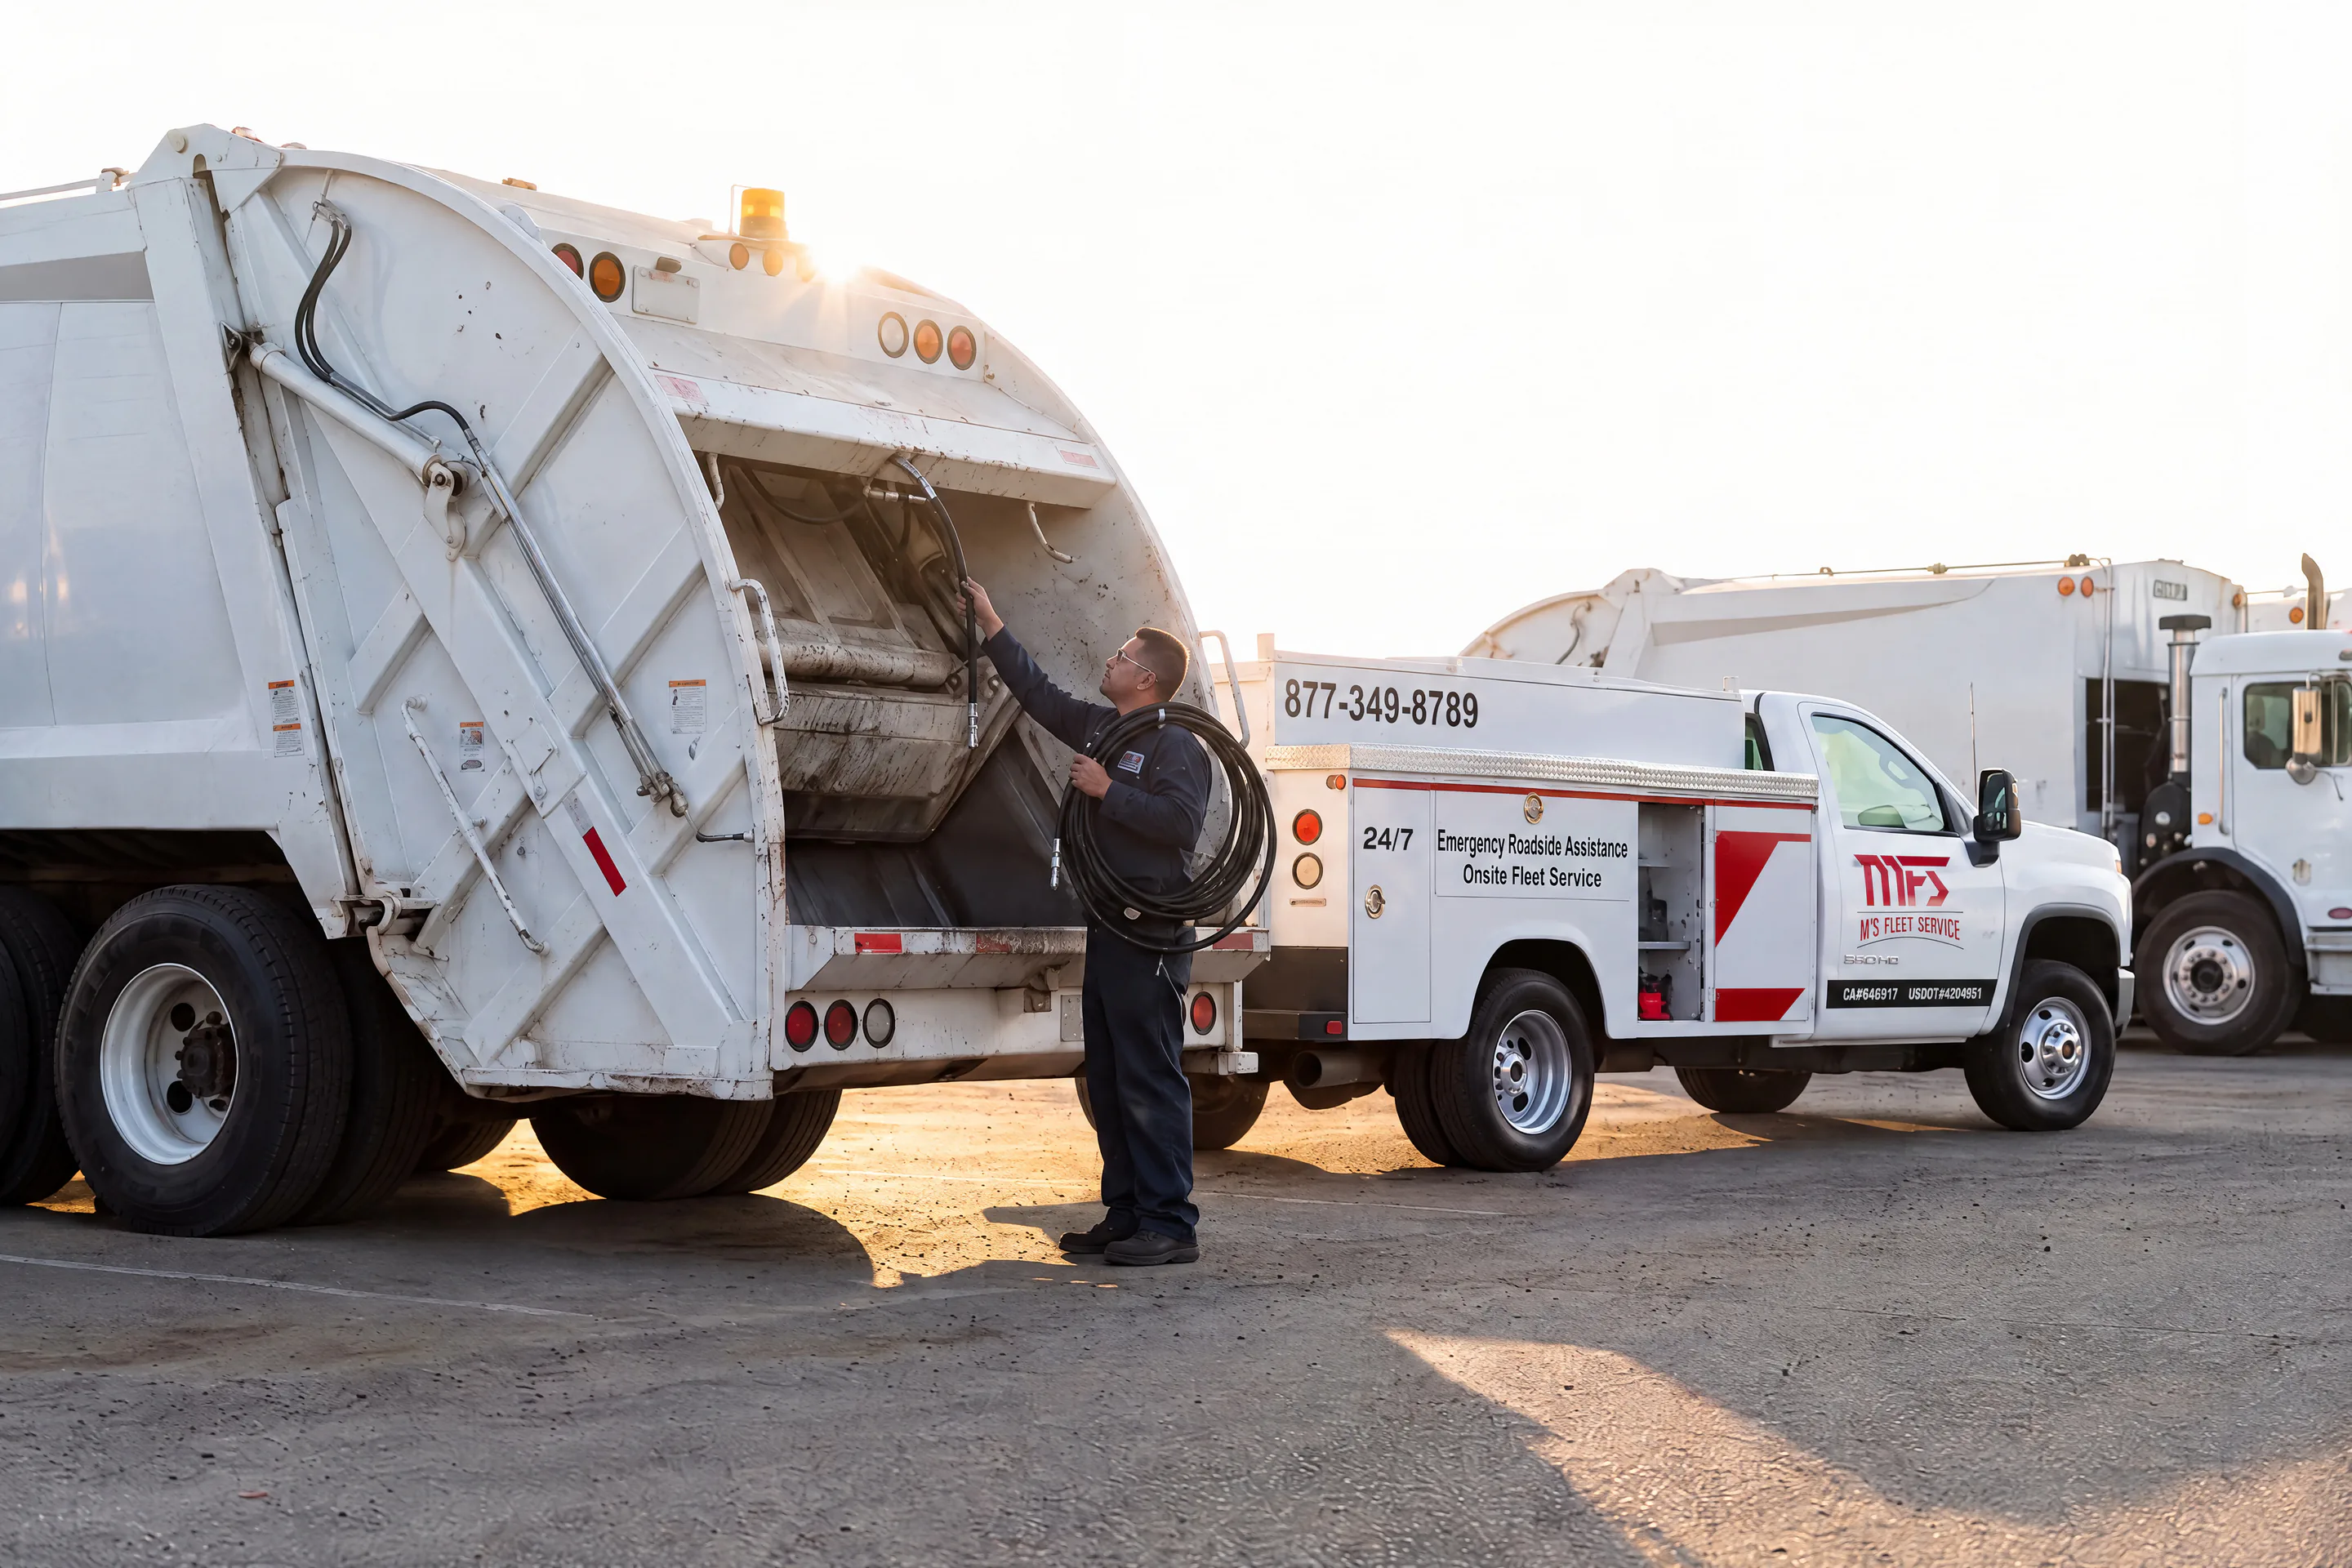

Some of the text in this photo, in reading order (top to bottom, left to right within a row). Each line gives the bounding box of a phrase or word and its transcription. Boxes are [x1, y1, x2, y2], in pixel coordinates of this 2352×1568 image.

[1285, 678, 1479, 728] 877-349-8789
[1363, 826, 1414, 852] 24/7
[1437, 828, 1628, 860] Emergency Roadside Assistance
[1463, 863, 1602, 888] Onsite Fleet Service
[1860, 916, 1960, 942] M'S FLEET SERVICE
[1842, 987, 1982, 1001] CA#646917 USDOT#4204951
